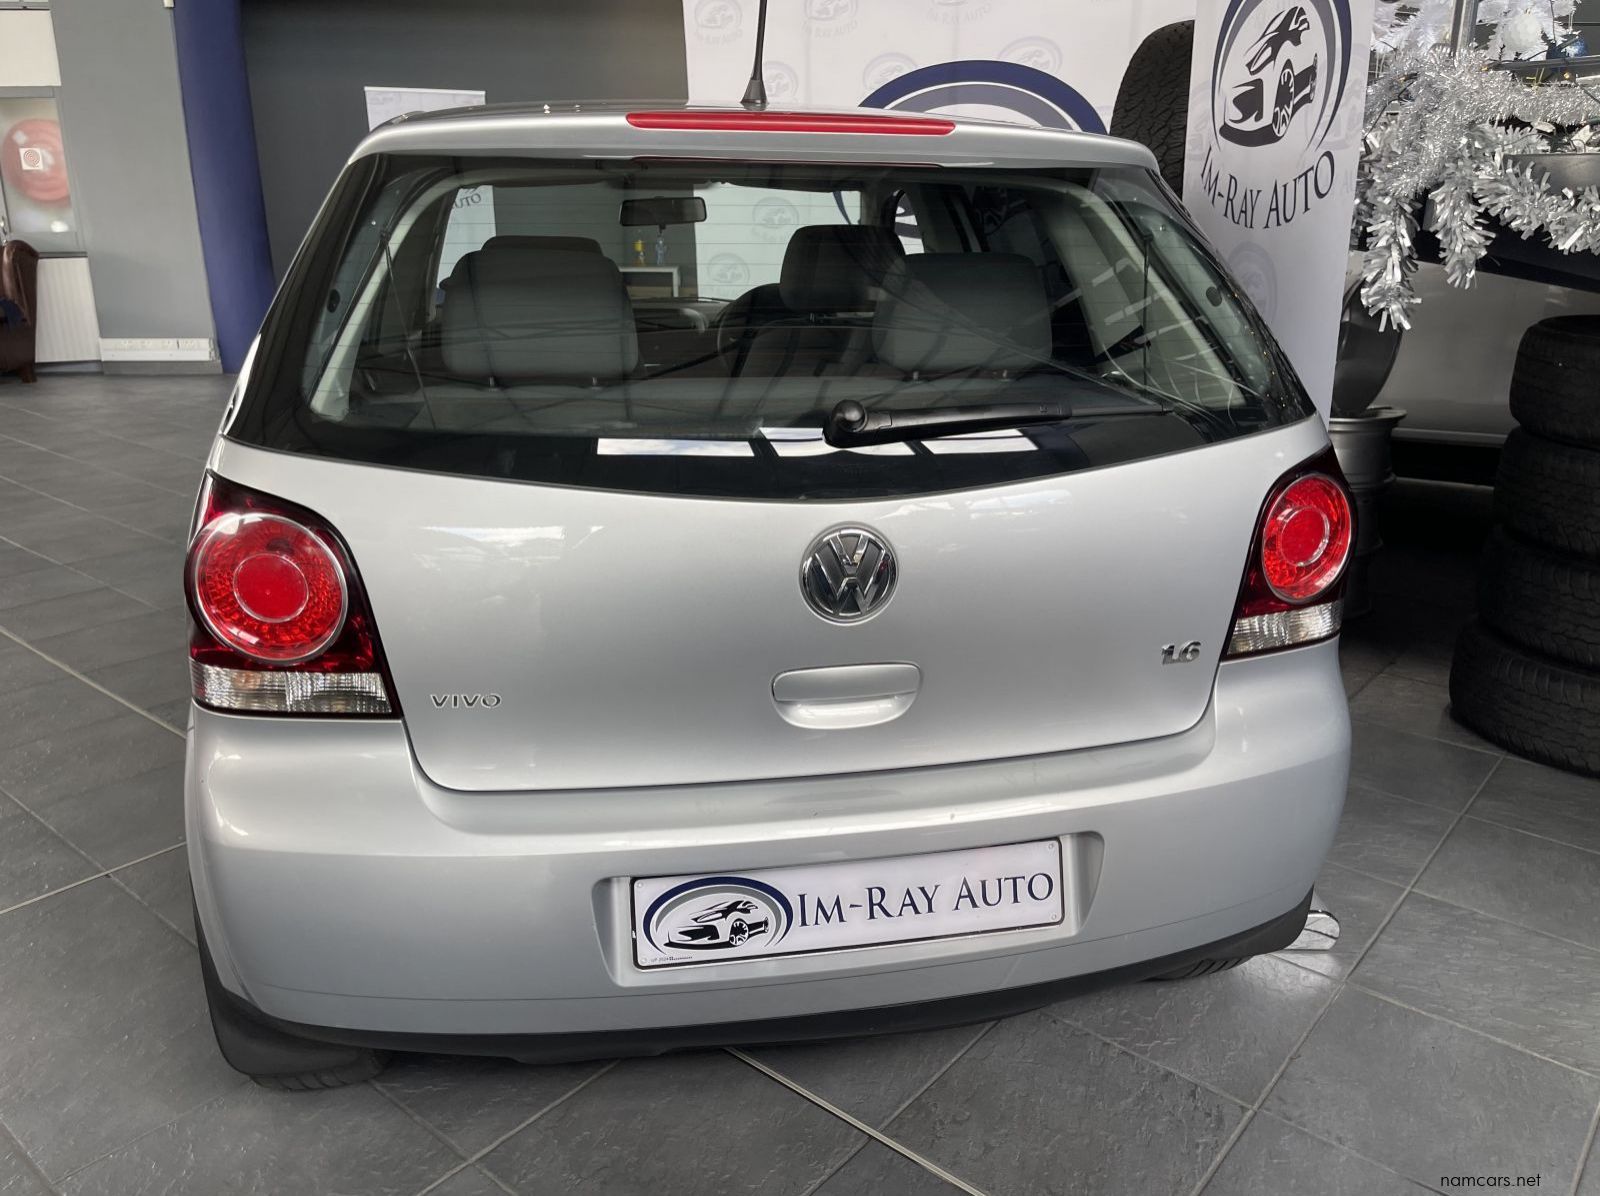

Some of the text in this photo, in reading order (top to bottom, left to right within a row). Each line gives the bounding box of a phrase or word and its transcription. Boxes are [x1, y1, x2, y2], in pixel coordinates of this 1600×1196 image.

[454, 193, 481, 209] UTO
[1200, 146, 1335, 229] IM-RAY AUTO
[430, 693, 502, 709] VIVO
[798, 871, 1054, 928] IM-RAY AUTO
